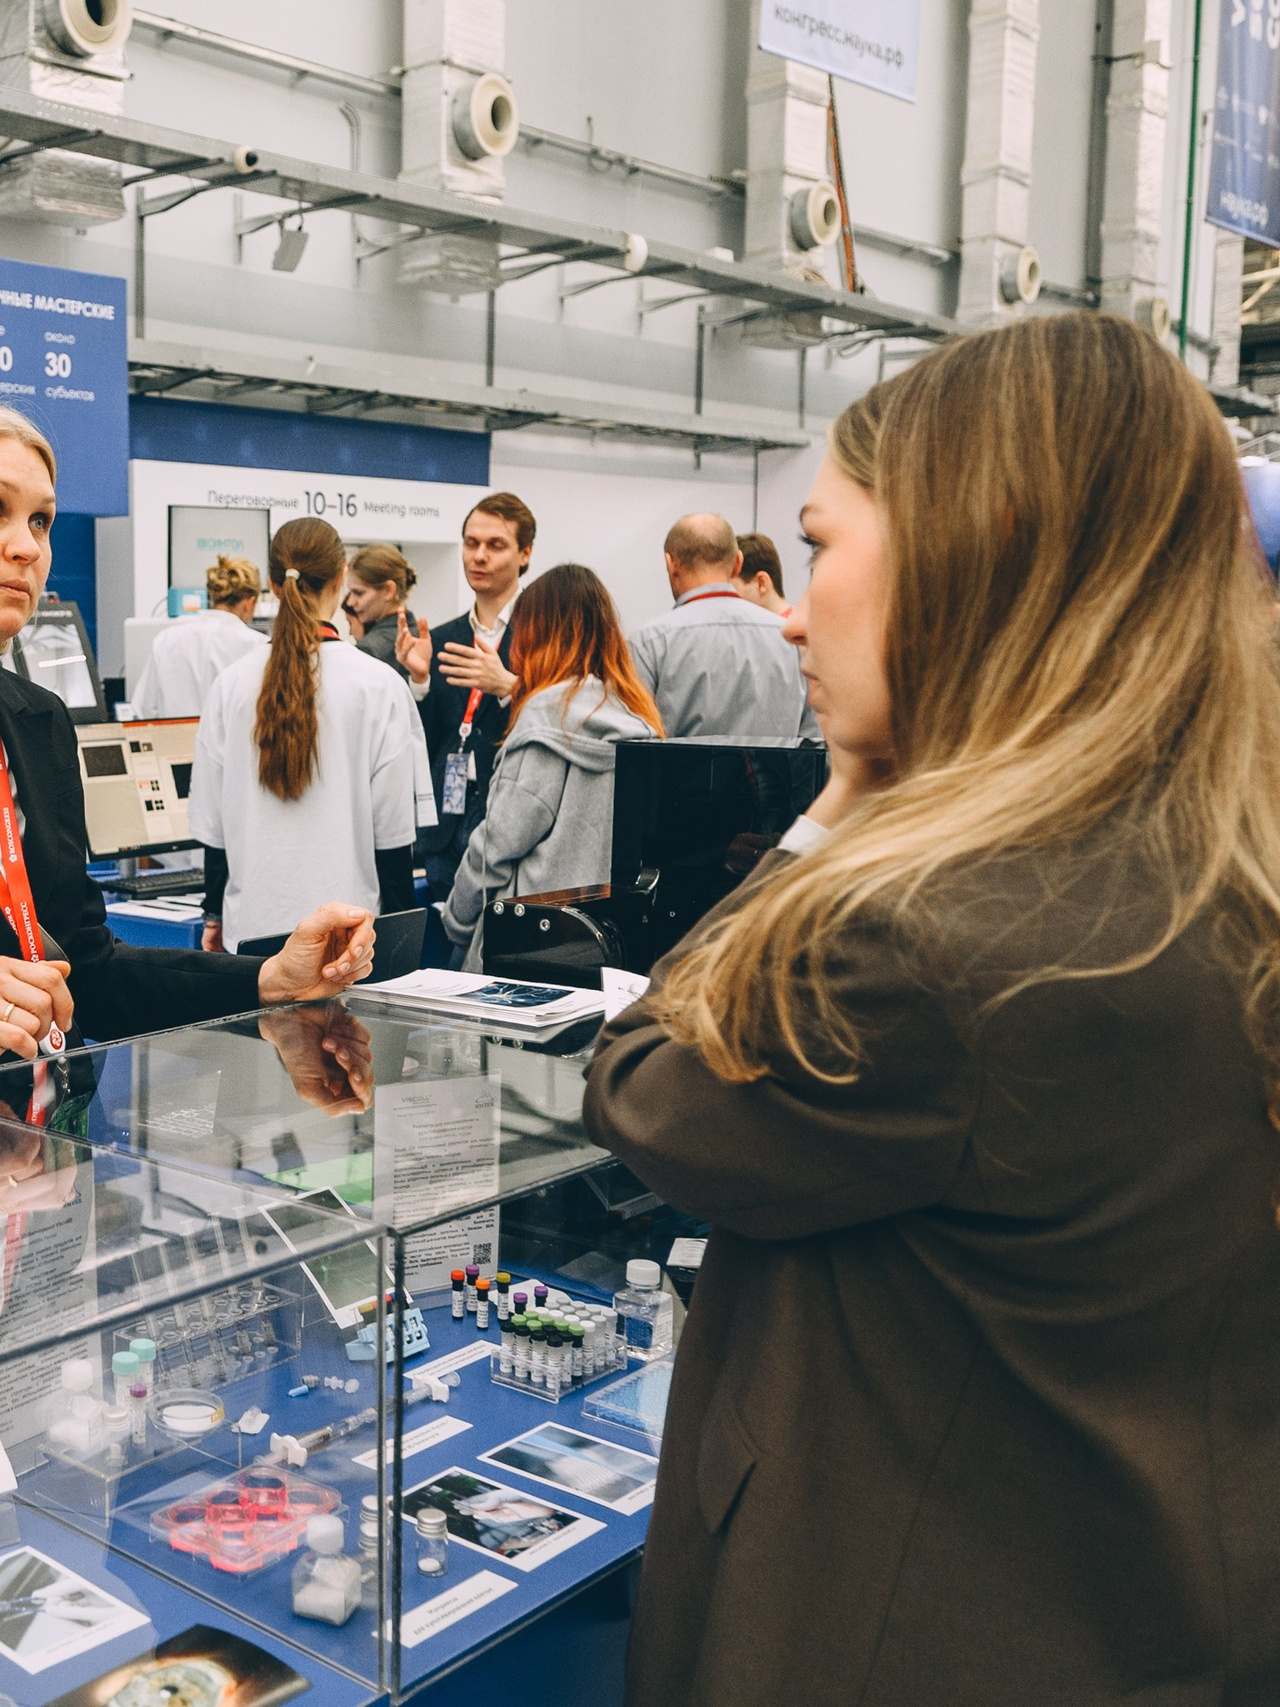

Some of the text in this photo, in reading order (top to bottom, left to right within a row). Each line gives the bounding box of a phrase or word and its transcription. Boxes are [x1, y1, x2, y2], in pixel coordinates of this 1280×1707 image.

[34, 294, 115, 321] МАСТЕРСКИЕ
[44, 352, 71, 378] 30
[208, 490, 299, 509] Переговорные
[364, 501, 407, 517] Meeting
[408, 505, 440, 518] rooms
[3, 806, 18, 855] ROSCONGRESS
[20, 900, 38, 956] РОСКОНГРЕСС
